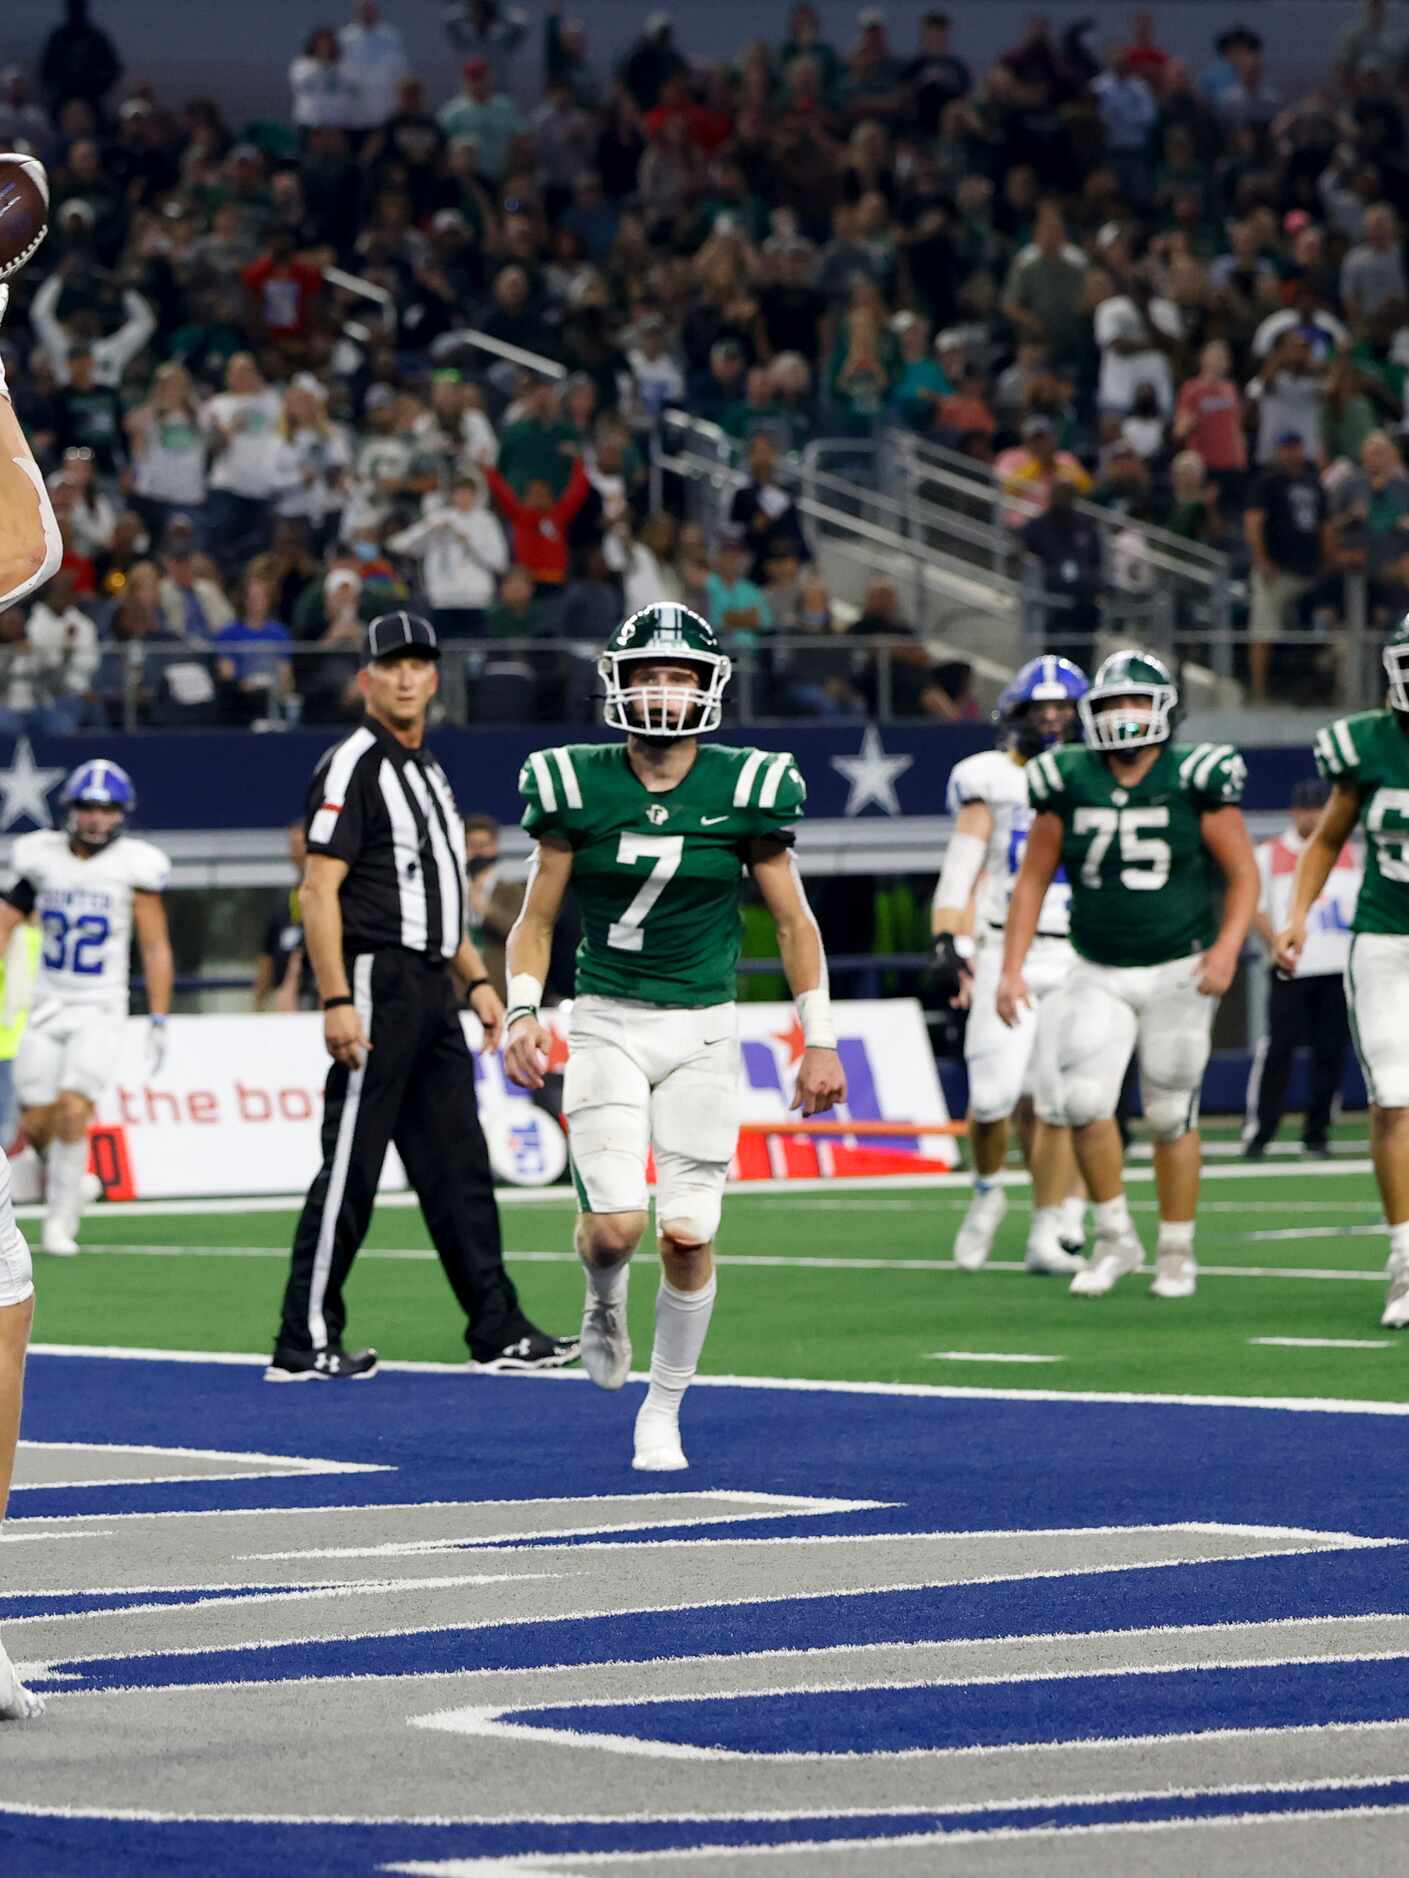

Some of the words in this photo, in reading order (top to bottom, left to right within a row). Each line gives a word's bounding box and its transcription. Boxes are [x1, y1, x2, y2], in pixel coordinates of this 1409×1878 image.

[1073, 806, 1171, 891] 75
[606, 832, 685, 951] 7
[42, 909, 110, 975] 32
[117, 1084, 221, 1125] the
[235, 1079, 325, 1124] bo
